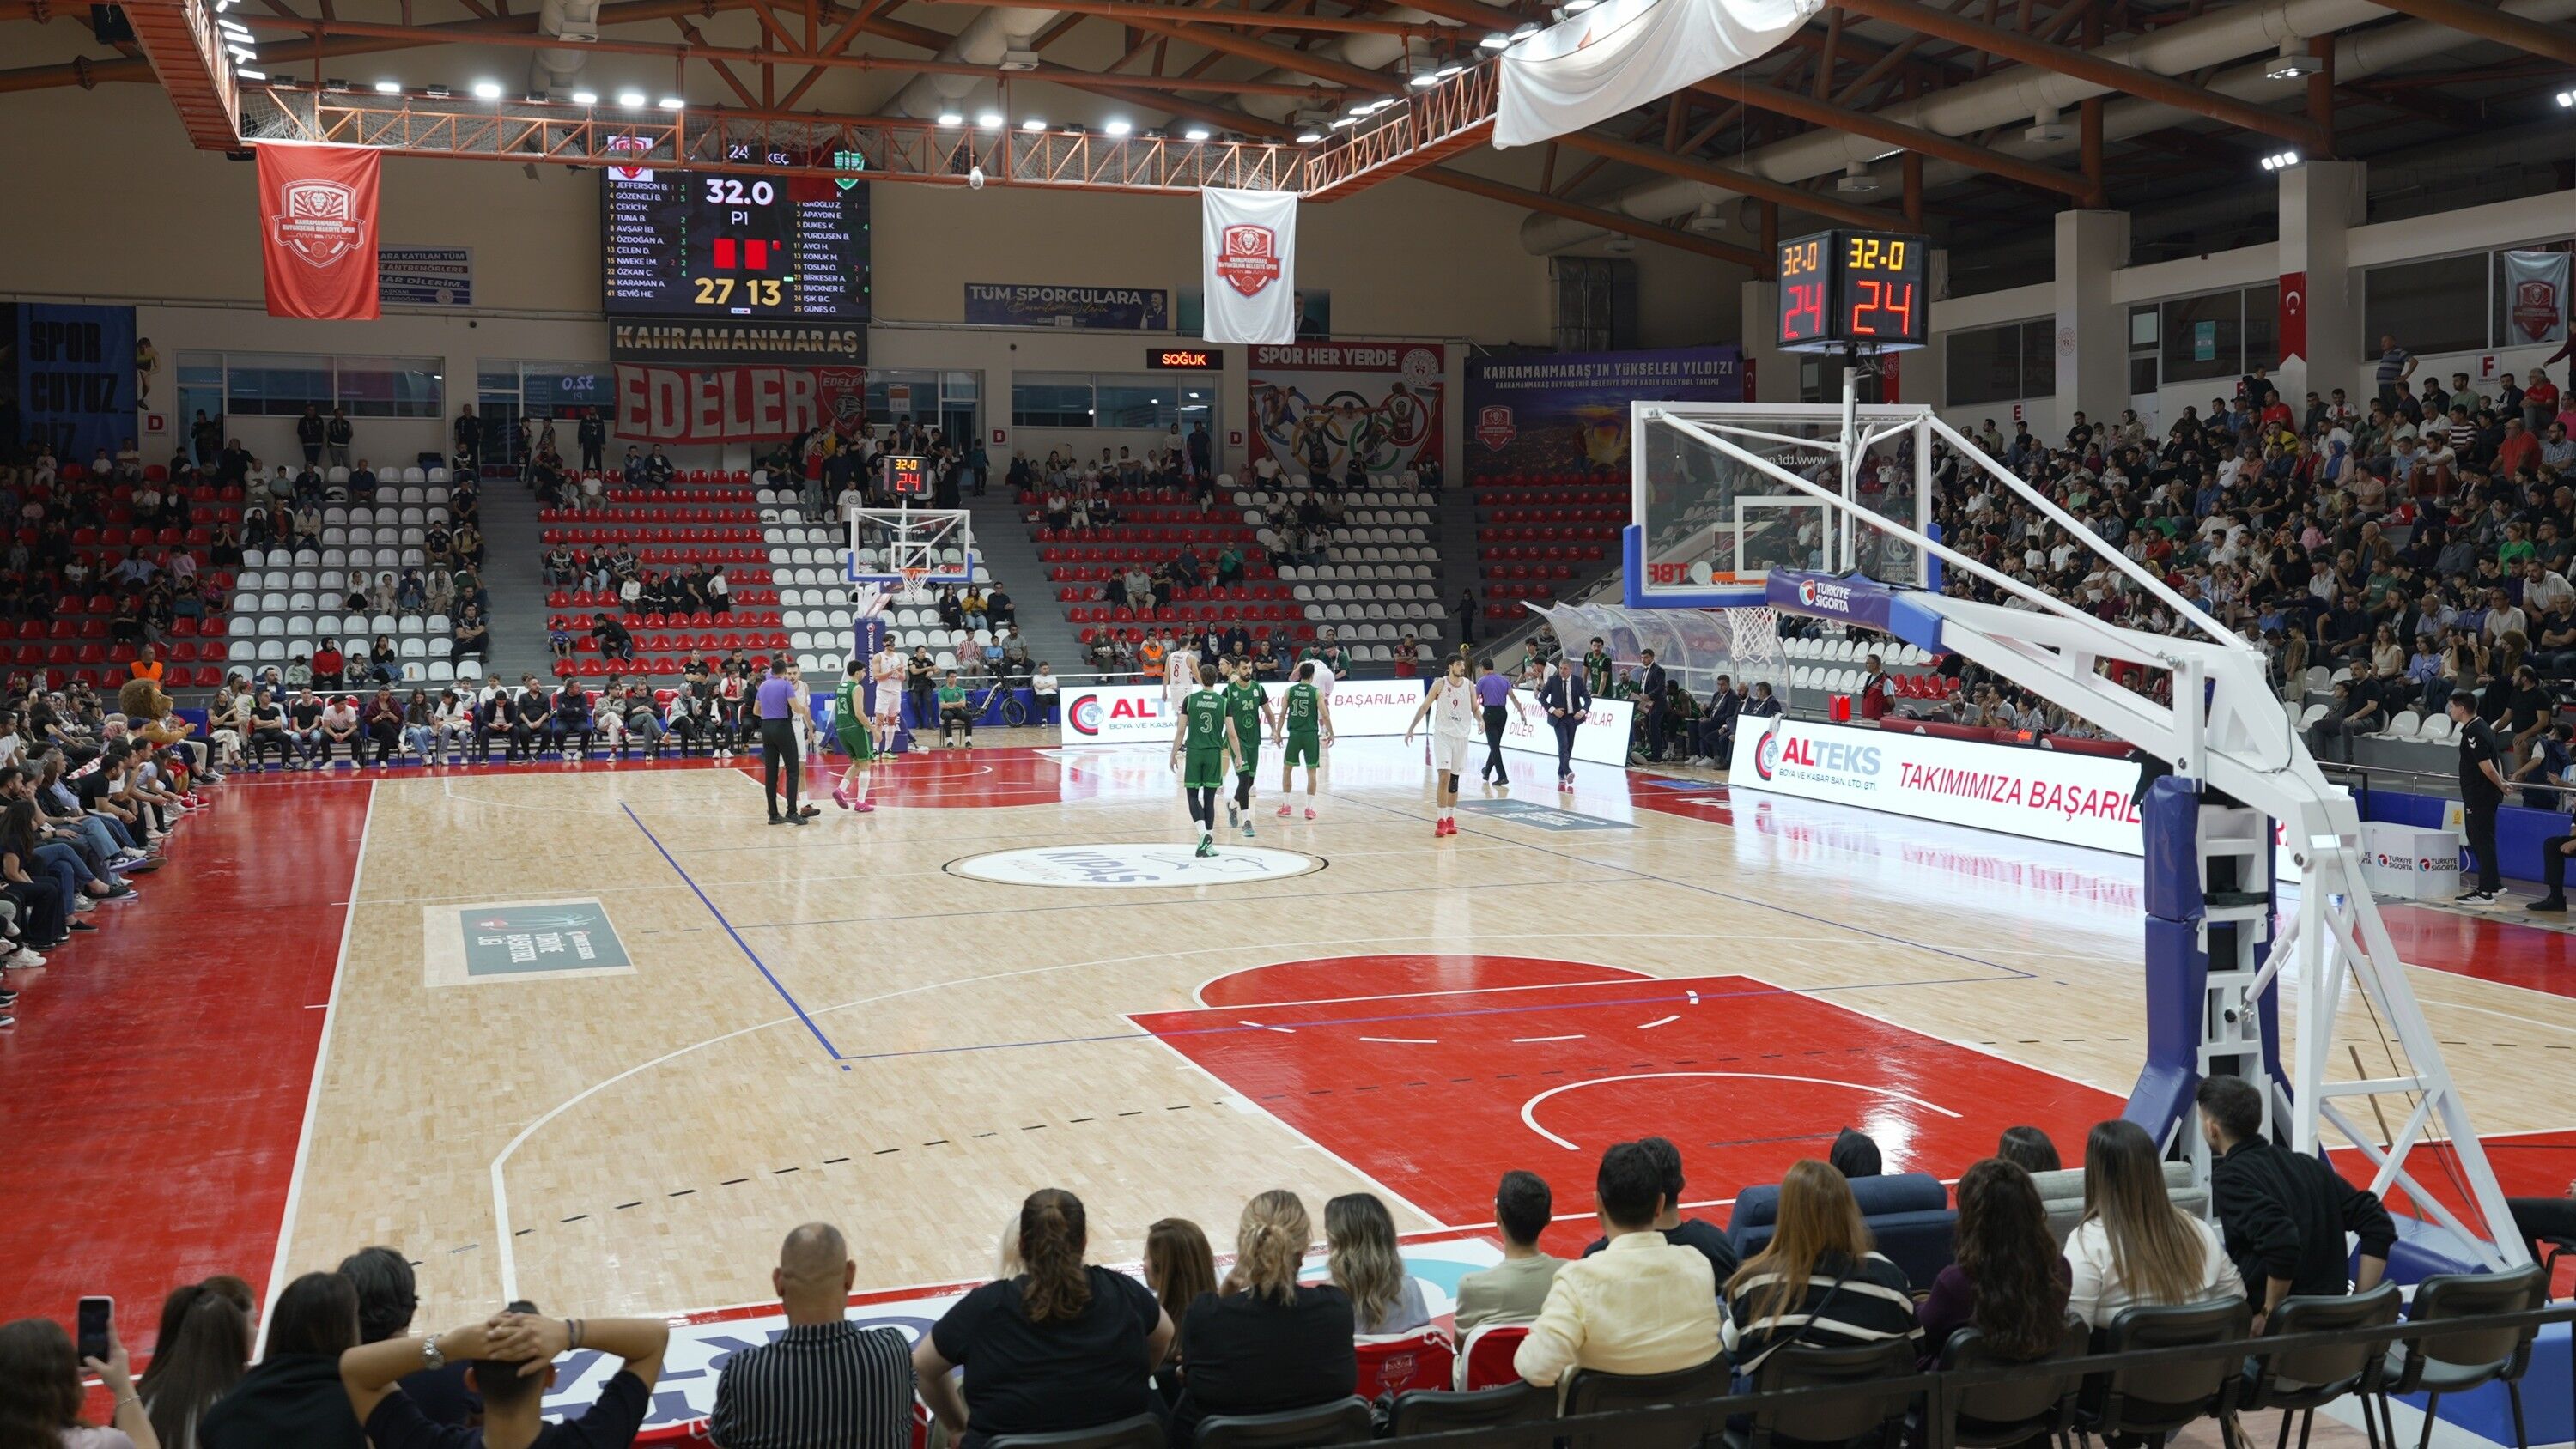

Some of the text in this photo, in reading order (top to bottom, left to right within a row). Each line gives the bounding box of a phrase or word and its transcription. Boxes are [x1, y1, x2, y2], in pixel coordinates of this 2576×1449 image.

[705, 179, 774, 205] 32.0
[731, 211, 749, 226] P1
[1783, 243, 1818, 276] 32.0
[1849, 239, 1905, 270] 32.0
[694, 277, 734, 305] 27
[746, 279, 782, 306] 13
[969, 285, 1142, 305] TÜM SPORCULARA
[1784, 283, 1823, 338] 24
[1852, 281, 1911, 336] 24
[29, 321, 101, 363] SPOR
[617, 325, 858, 358] KAHRAMANMARAŞ
[1162, 352, 1206, 365] SOĞUK
[1258, 347, 1397, 367] SPOR HER YERDE
[2483, 357, 2494, 376] F
[1484, 361, 1733, 379] KAHRAMANMARAŞ'IN YÜKSELEN YILDIZI
[615, 364, 817, 438] EDELER
[148, 415, 163, 430] D
[2013, 404, 2022, 422] E
[993, 429, 1006, 444] D
[1230, 432, 1242, 445] D
[896, 459, 917, 470] 32.0
[896, 473, 920, 492] 24
[1174, 664, 1180, 677] 8
[1242, 700, 1254, 711] 24
[1291, 700, 1309, 717] 15
[1334, 694, 1417, 708] BAŞARILAR
[1453, 699, 1458, 709] 9
[1200, 712, 1212, 733] 3
[1782, 737, 1881, 775] ALTEKS
[1779, 769, 1795, 780] BOYA
[1797, 772, 1806, 780] VE
[1807, 773, 1830, 785] KASAR
[1831, 776, 1846, 787] SAN.
[1848, 779, 1862, 790] LTD.
[1900, 762, 2021, 806] TAKIMIMIZA
